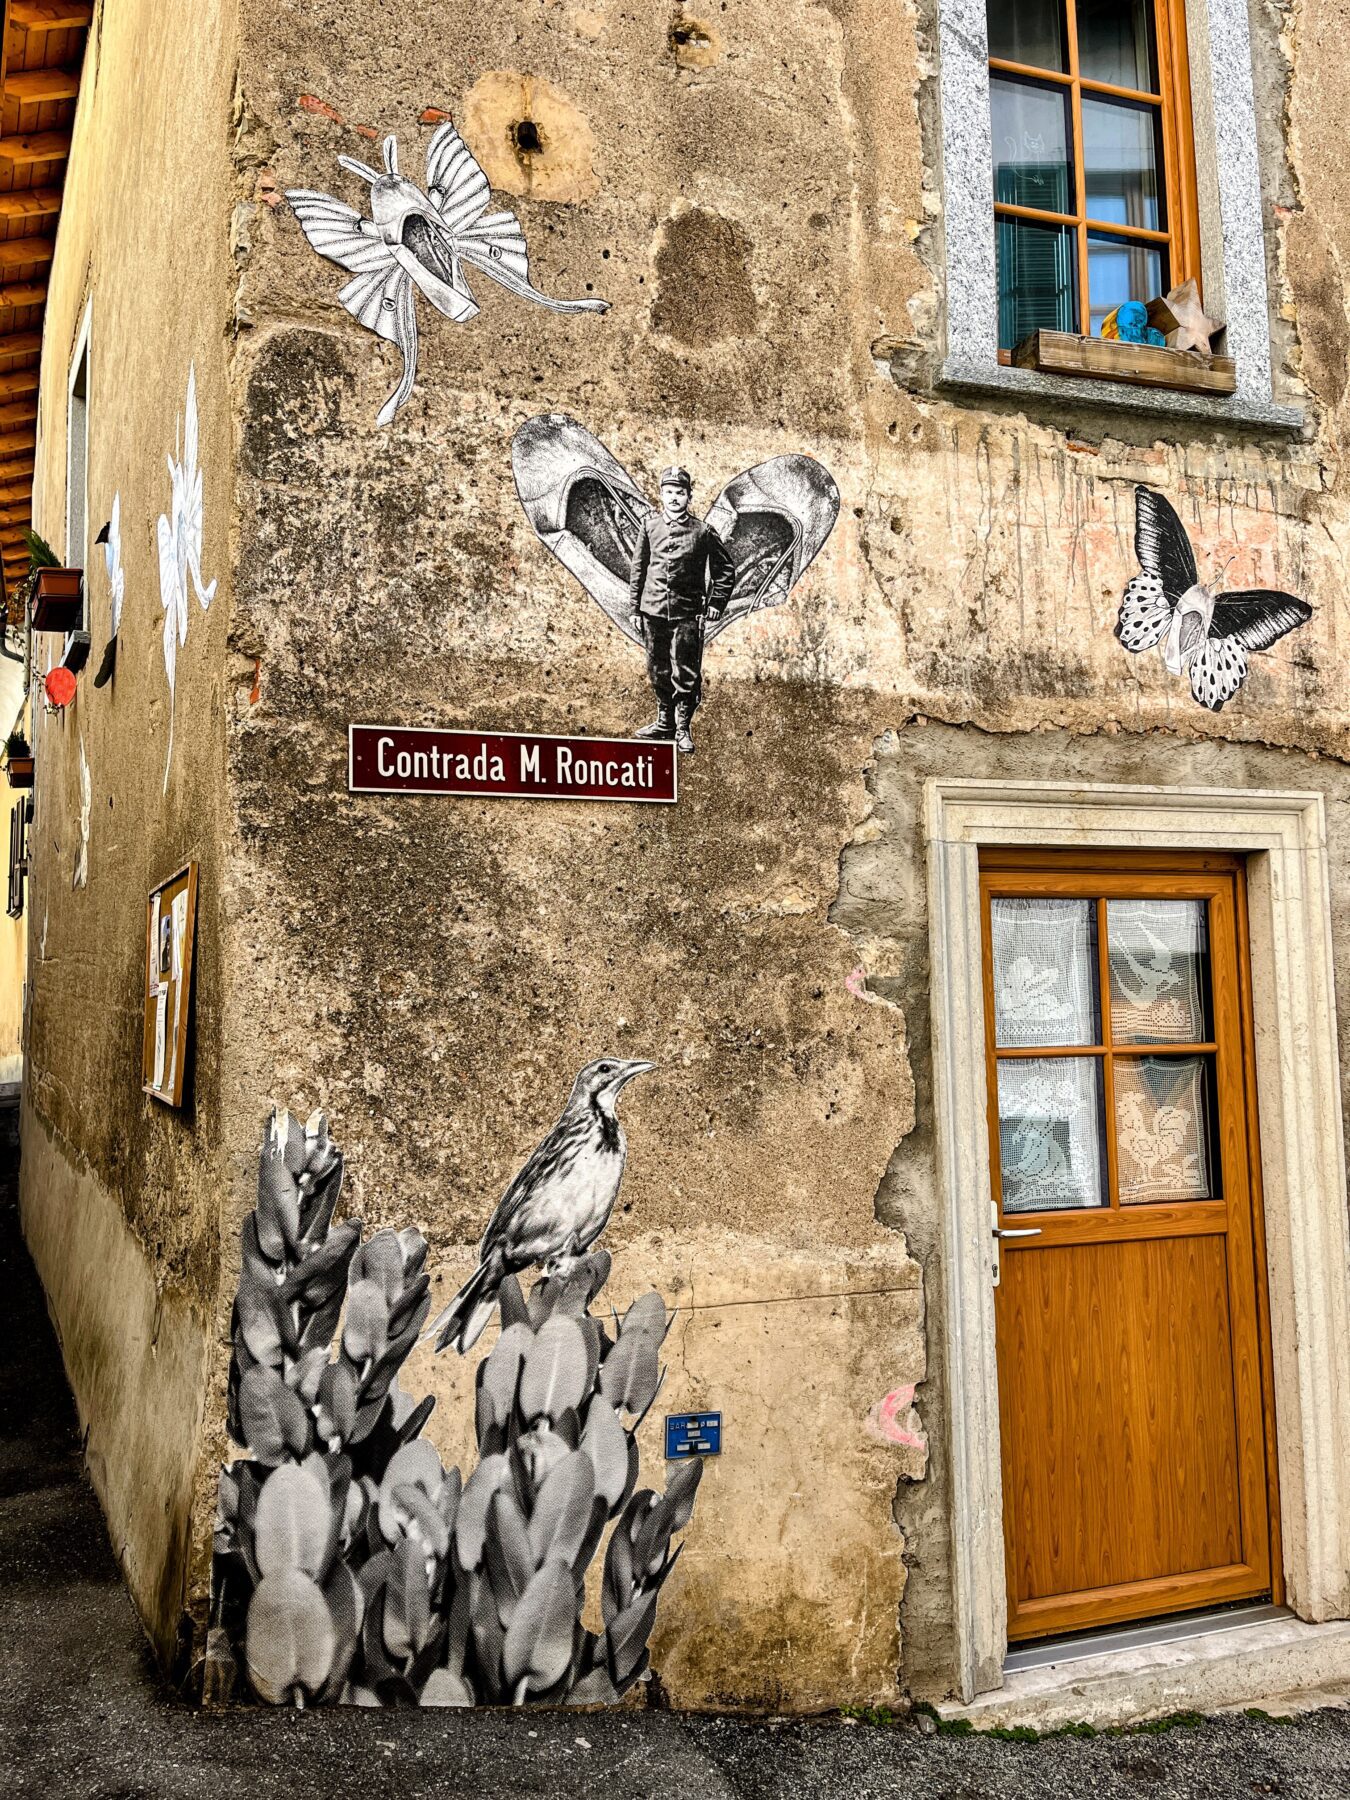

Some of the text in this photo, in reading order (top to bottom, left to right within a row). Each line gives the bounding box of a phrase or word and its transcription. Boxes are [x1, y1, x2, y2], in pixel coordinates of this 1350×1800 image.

[377, 737, 653, 788] Contrada M. Roncati
